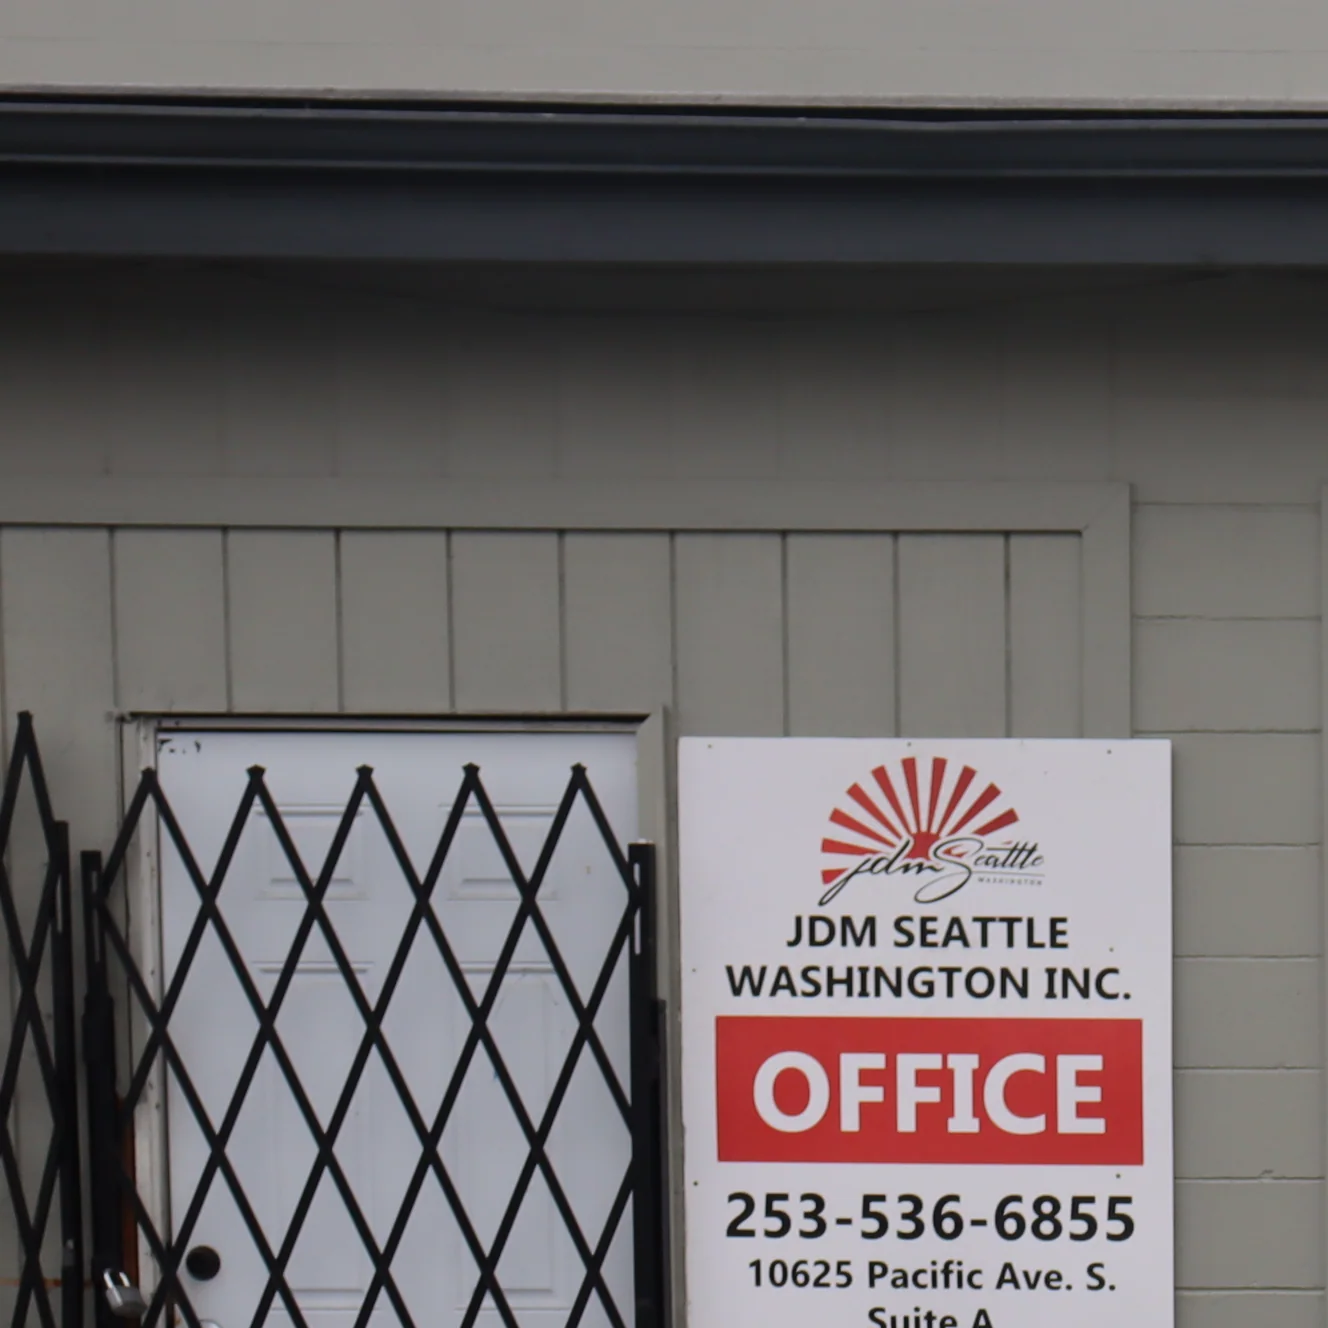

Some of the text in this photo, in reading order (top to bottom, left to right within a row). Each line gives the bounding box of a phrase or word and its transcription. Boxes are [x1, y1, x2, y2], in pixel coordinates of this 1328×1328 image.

[914, 837, 1045, 903] Seattle
[787, 915, 1069, 949] JDM SEATTLE
[725, 965, 1131, 1000] WASHINGTON INC.
[753, 1050, 1106, 1135] OFFICE
[726, 1191, 1135, 1242] 253-536-6855
[749, 1259, 1116, 1291] 10625 Pacific Ave. S.
